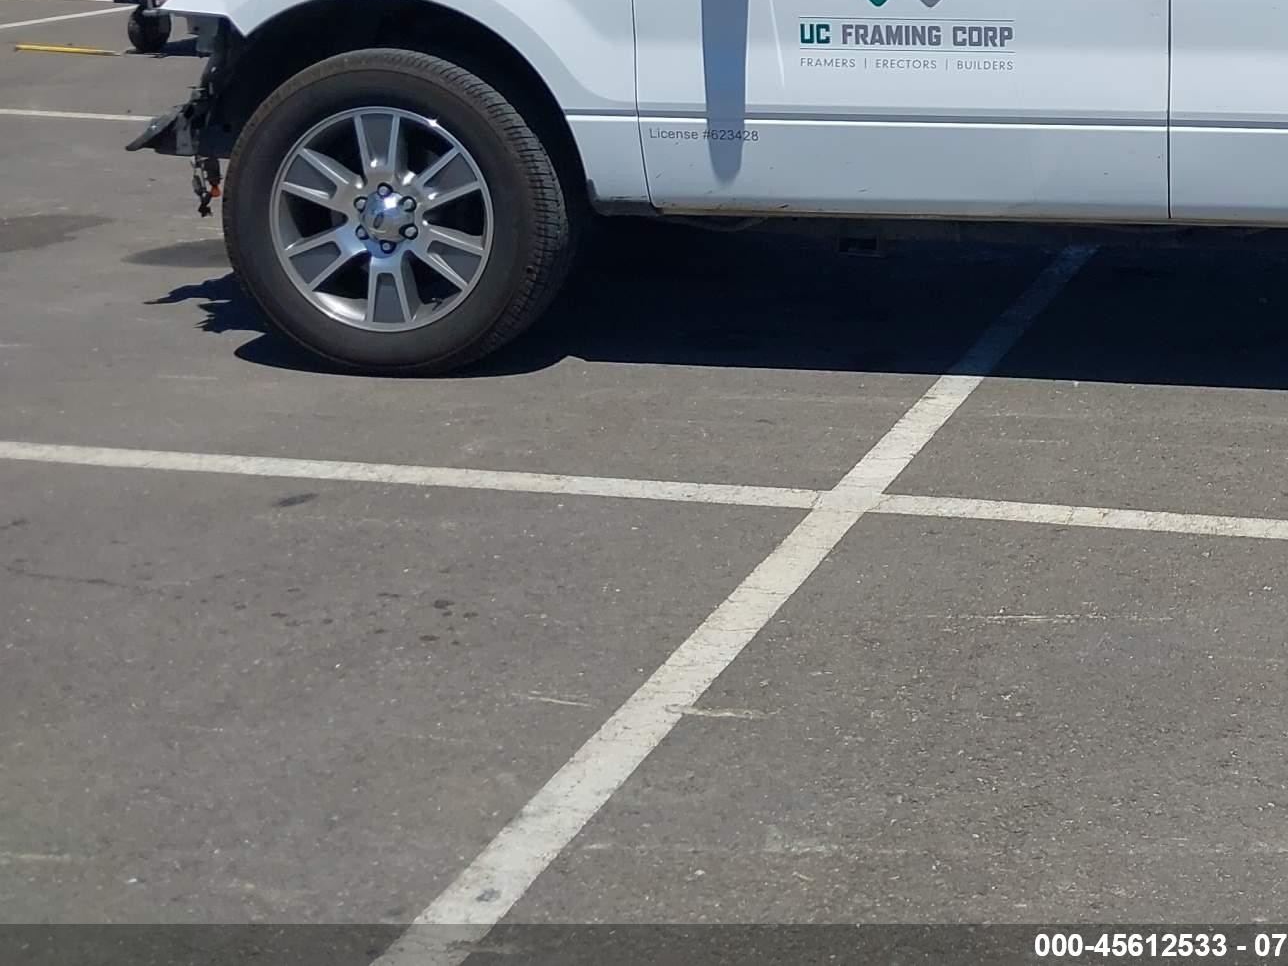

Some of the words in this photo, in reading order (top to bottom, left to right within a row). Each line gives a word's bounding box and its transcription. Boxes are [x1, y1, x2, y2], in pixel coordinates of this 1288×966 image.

[799, 23, 831, 45] UC
[841, 24, 942, 47] FRAMING
[952, 25, 1014, 48] CORP
[800, 57, 856, 68] FRAMERS
[875, 58, 937, 70] ERECTORS
[956, 59, 1014, 71] BUILDERS
[649, 127, 699, 140] License
[702, 129, 759, 142] #623428
